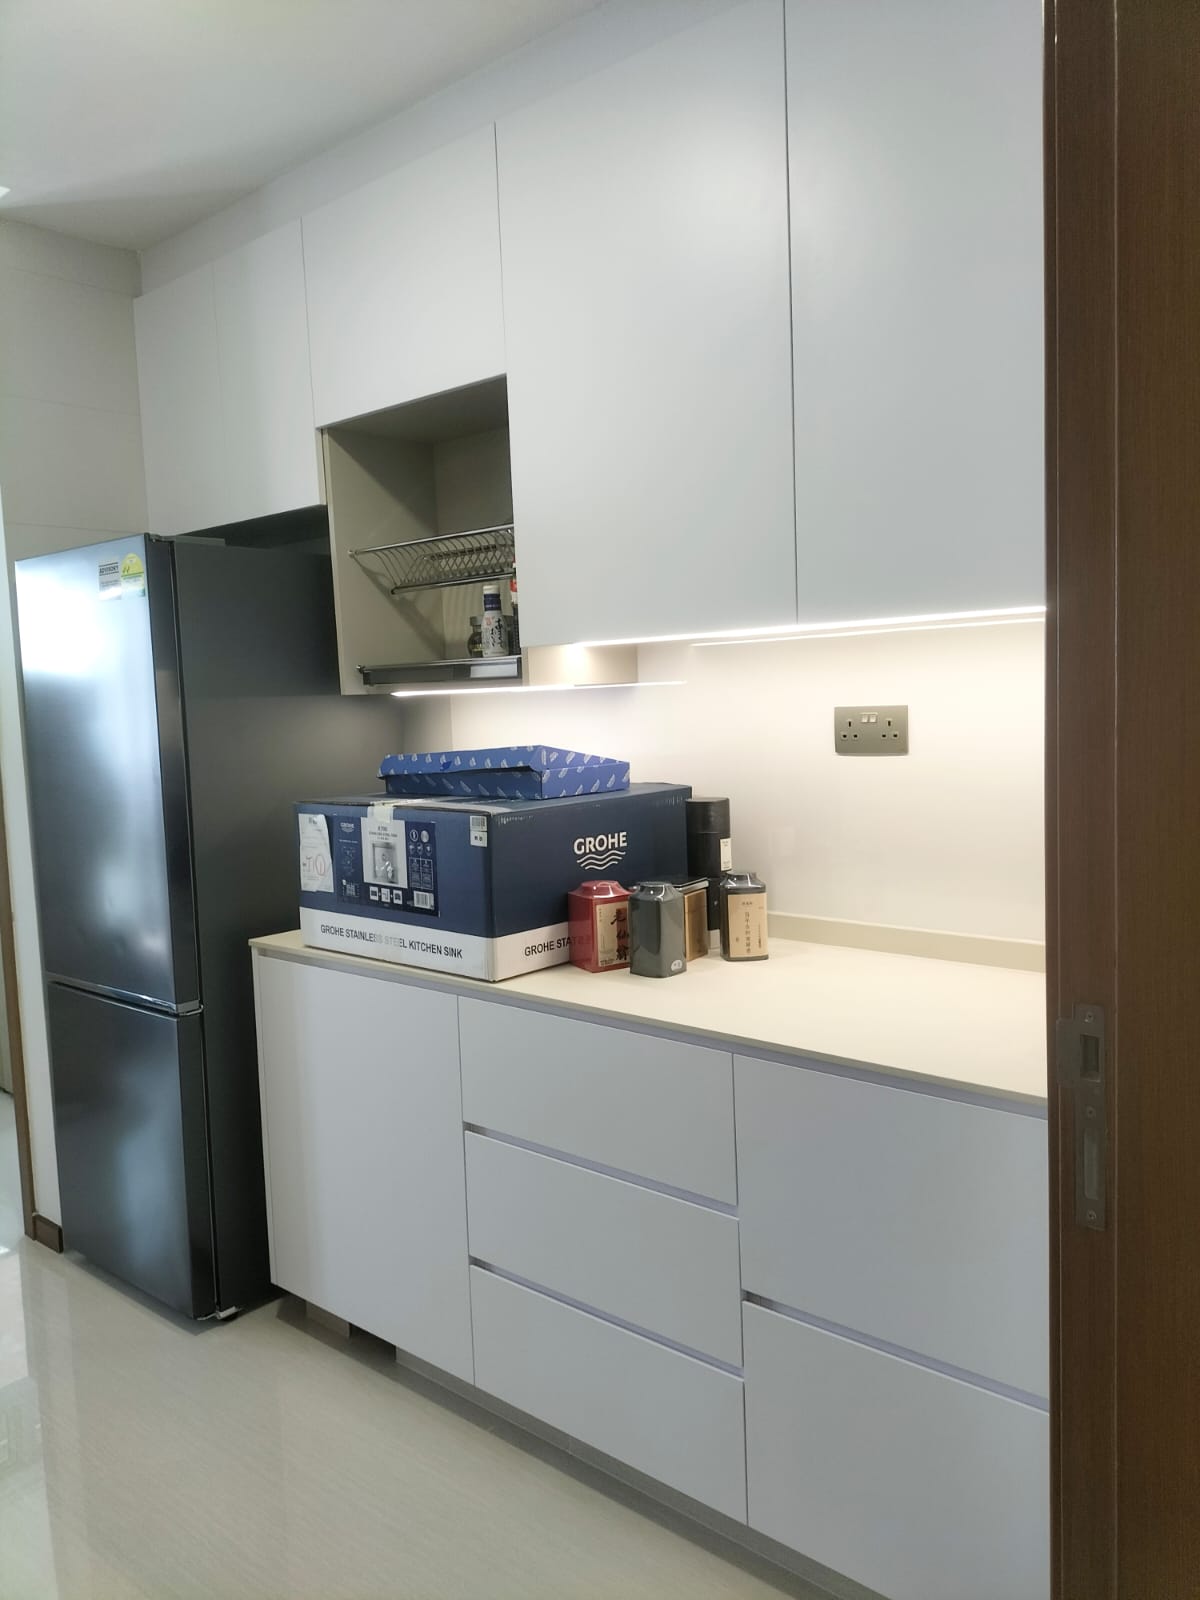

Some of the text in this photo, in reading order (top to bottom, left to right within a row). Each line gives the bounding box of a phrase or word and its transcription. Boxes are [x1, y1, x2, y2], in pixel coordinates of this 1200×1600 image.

[573, 831, 628, 855] GROHE
[320, 924, 463, 959] GROHE STAINLESS STEEL KITCHEN SINK
[524, 940, 555, 956] GROHE
